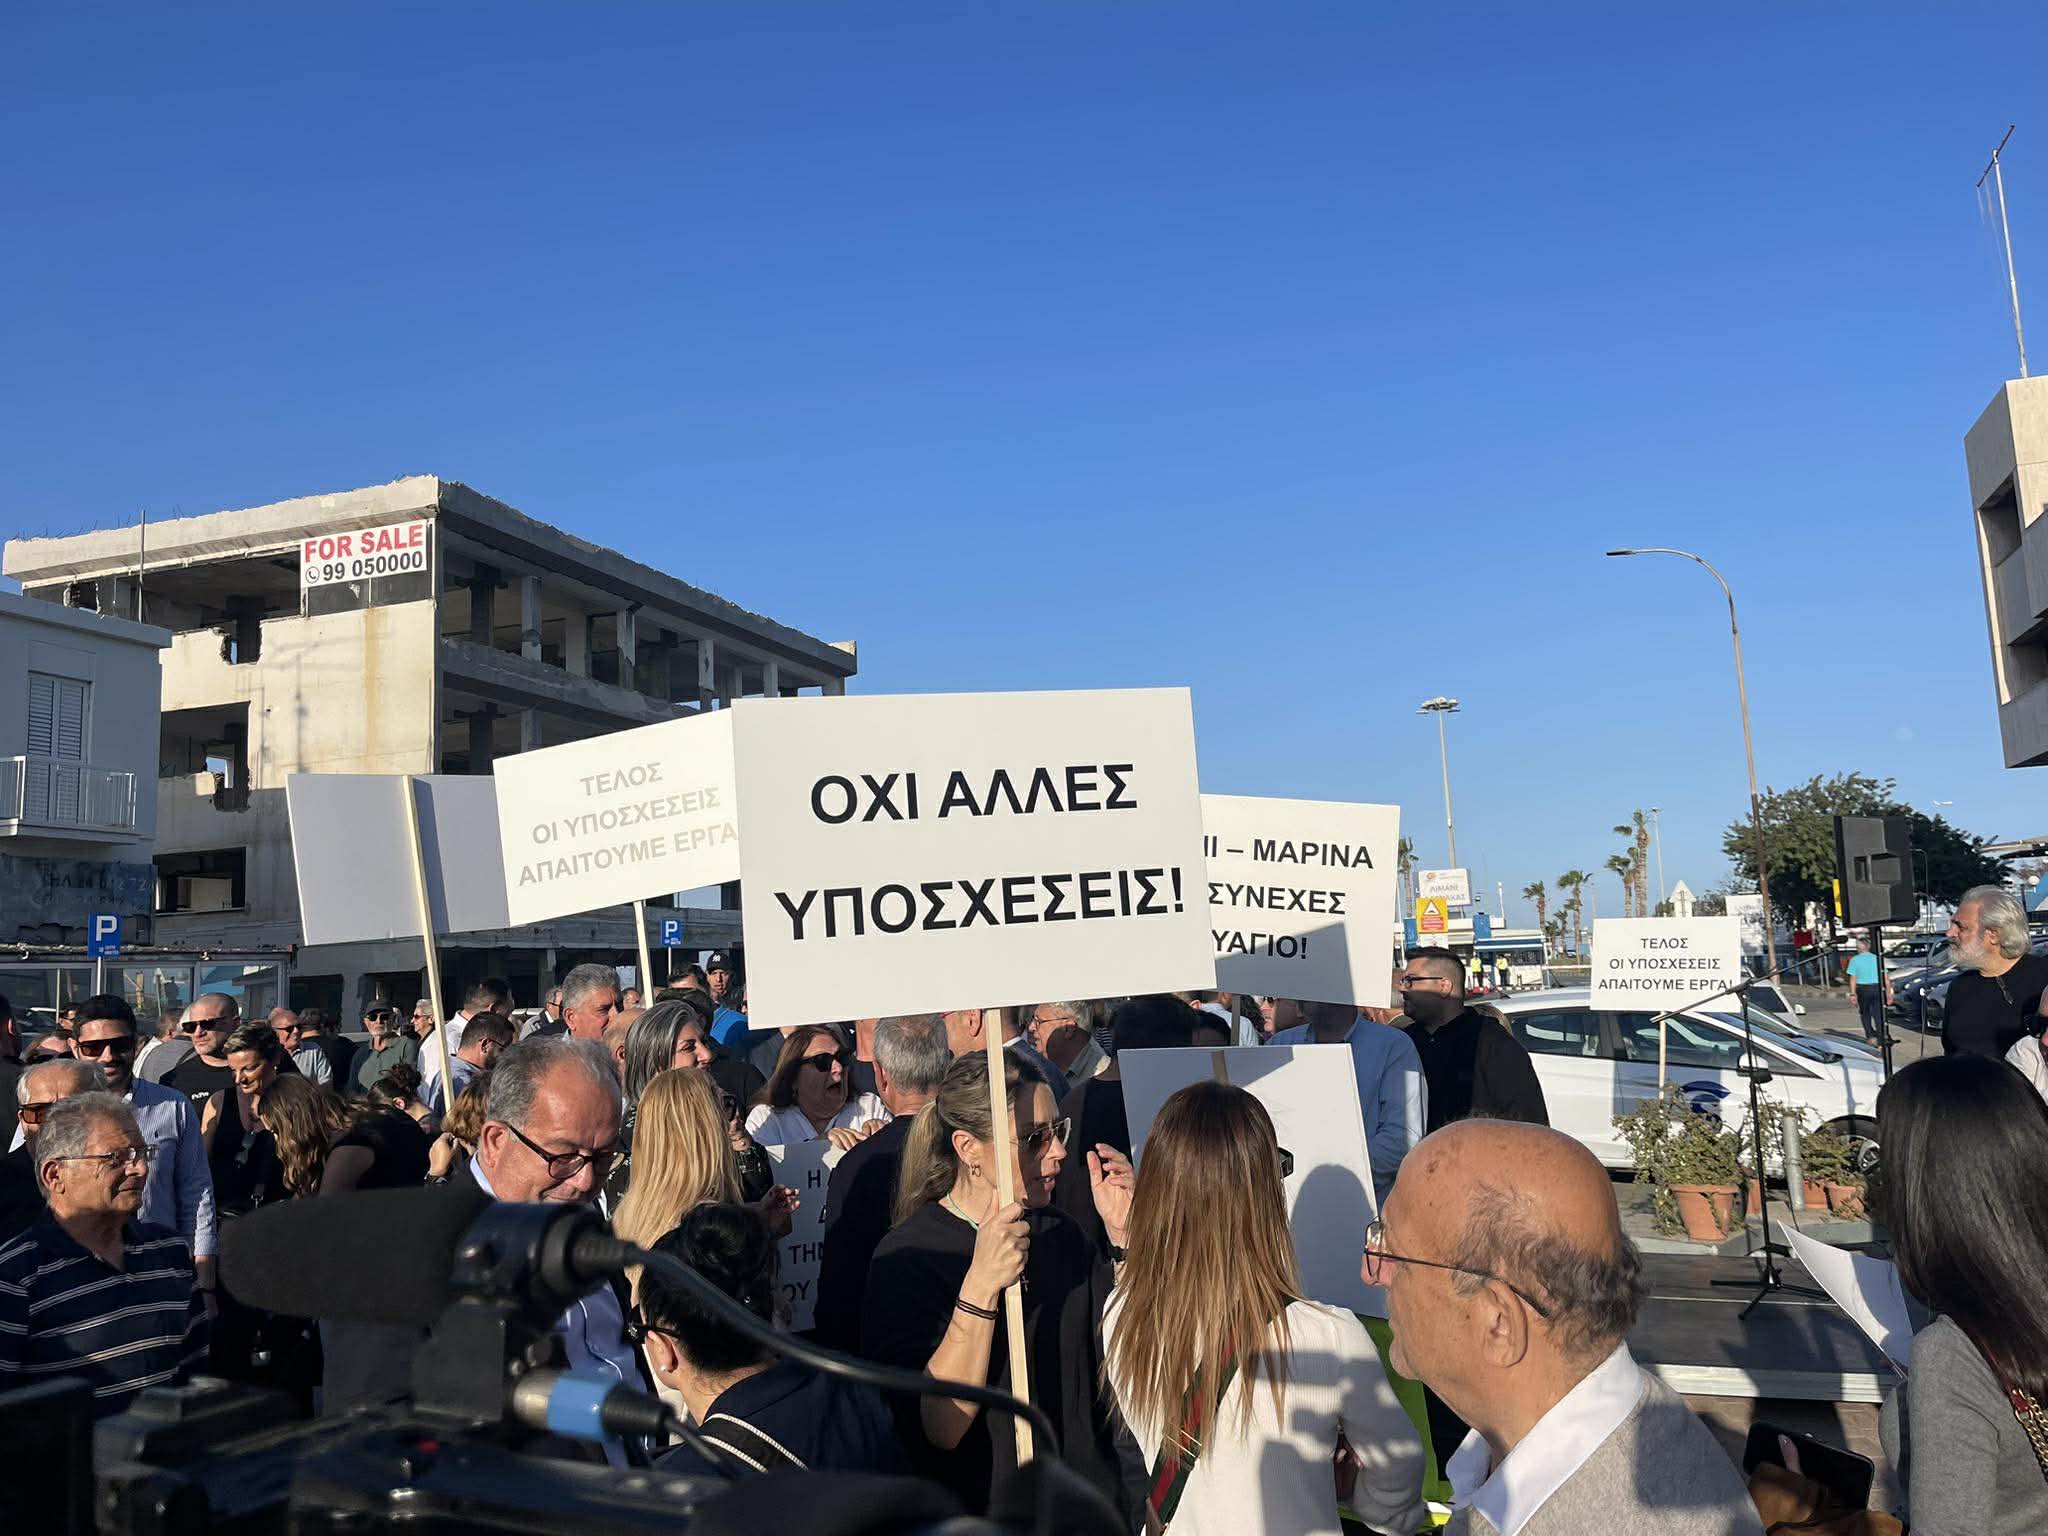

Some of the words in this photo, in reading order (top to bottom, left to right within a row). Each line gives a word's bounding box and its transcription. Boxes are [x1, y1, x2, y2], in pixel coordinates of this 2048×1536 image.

[305, 535, 352, 563] FOR
[360, 524, 423, 554] SALE
[323, 562, 345, 581] 99
[352, 551, 423, 577] 050000
[579, 762, 664, 796] ΤΕΛΟΣ
[811, 773, 919, 824] ΟΧΙ
[937, 763, 1138, 818] ΑΛΛΕΣ
[532, 821, 559, 845] ΟΙ
[564, 787, 721, 838] ΥΠΟΣΧΕΣΕΙΣ
[518, 836, 667, 886] ΑΠΑΙΤΟΥΜΕ
[1253, 839, 1374, 869] ΜΑΡΙΝΑ
[773, 866, 1184, 941] ΥΠΟΣΧΕΣΕΙΣ!
[1208, 882, 1346, 915] ΣΥΝΕΧΕΣ
[95, 915, 118, 942] P
[665, 920, 678, 938] P
[1640, 938, 1689, 949] ΤΕΛΟΣ
[1609, 958, 1624, 970] ΟΙ
[1628, 958, 1721, 970] ΥΠΟΣΧΕΣΕΙΣ
[1598, 979, 1685, 990] ΑΠΑΙΤΟΥΜΕ
